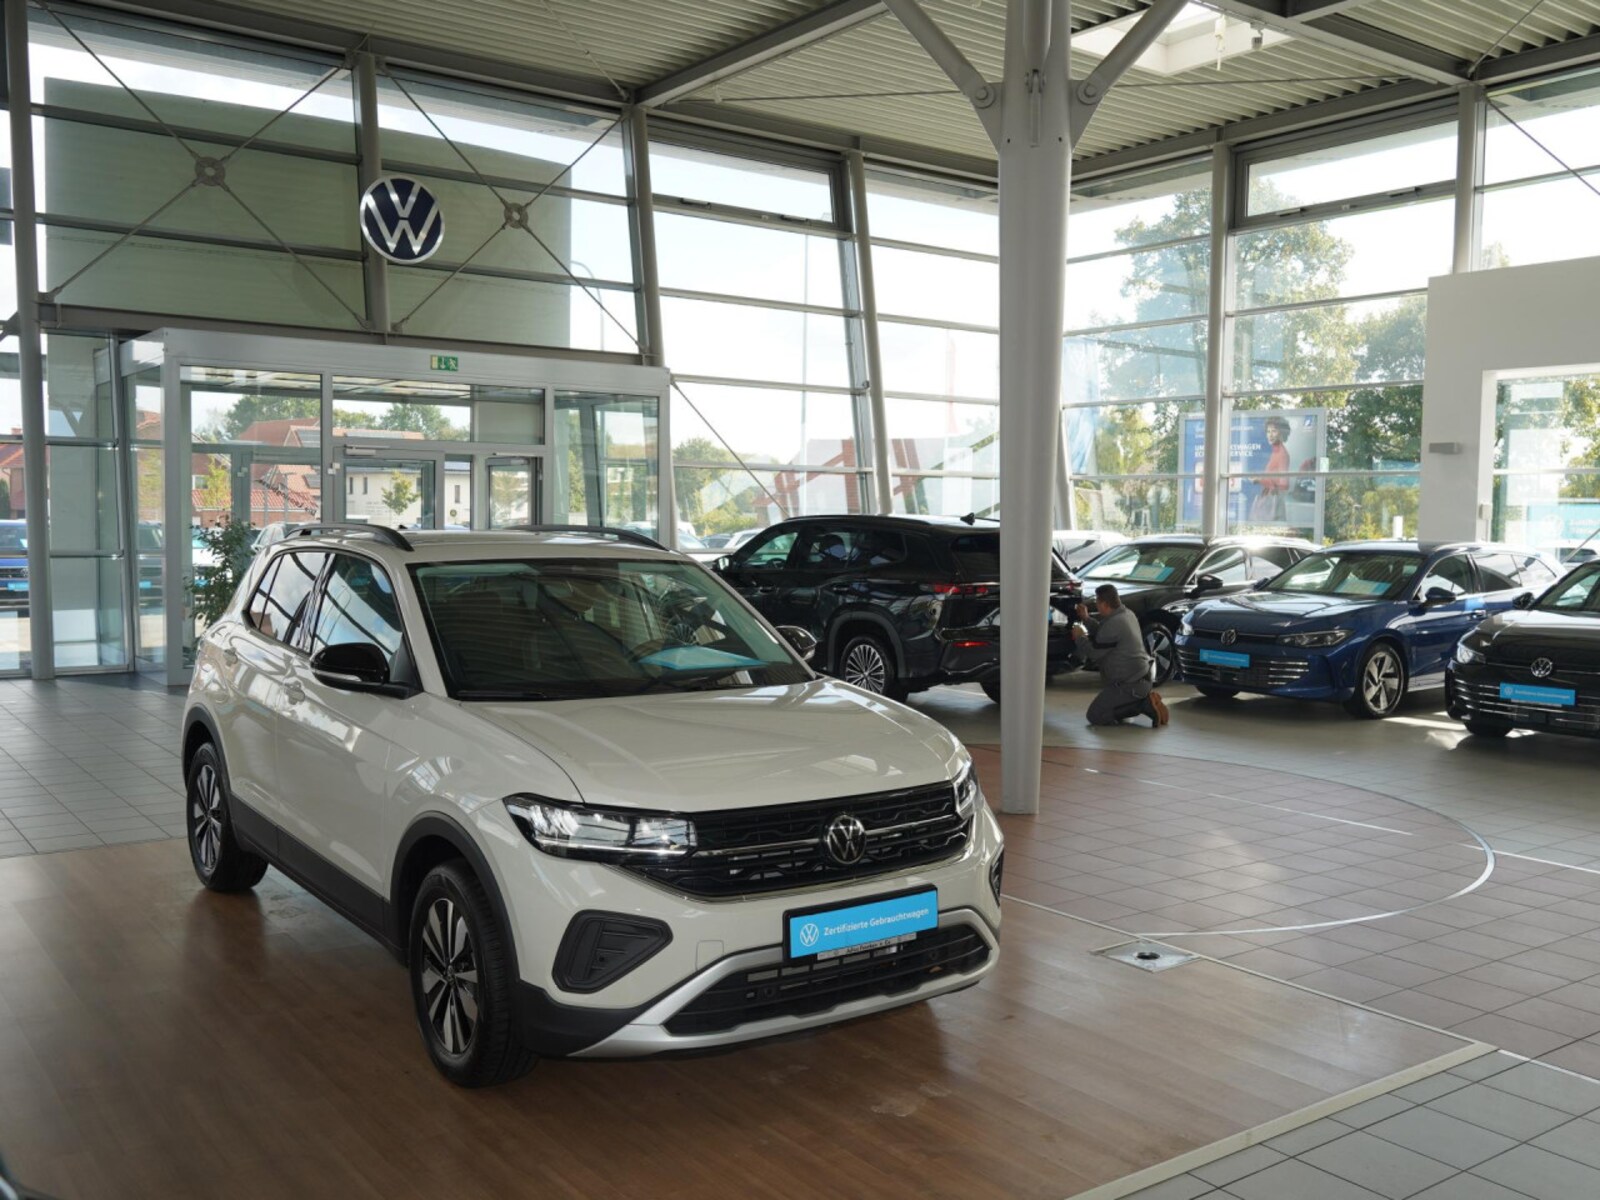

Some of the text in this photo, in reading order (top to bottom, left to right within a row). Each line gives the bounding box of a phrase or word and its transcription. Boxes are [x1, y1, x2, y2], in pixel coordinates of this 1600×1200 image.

[360, 176, 445, 264] VW
[823, 920, 868, 936] Zertifizierte
[869, 908, 929, 927] Gebrauchtwagen
